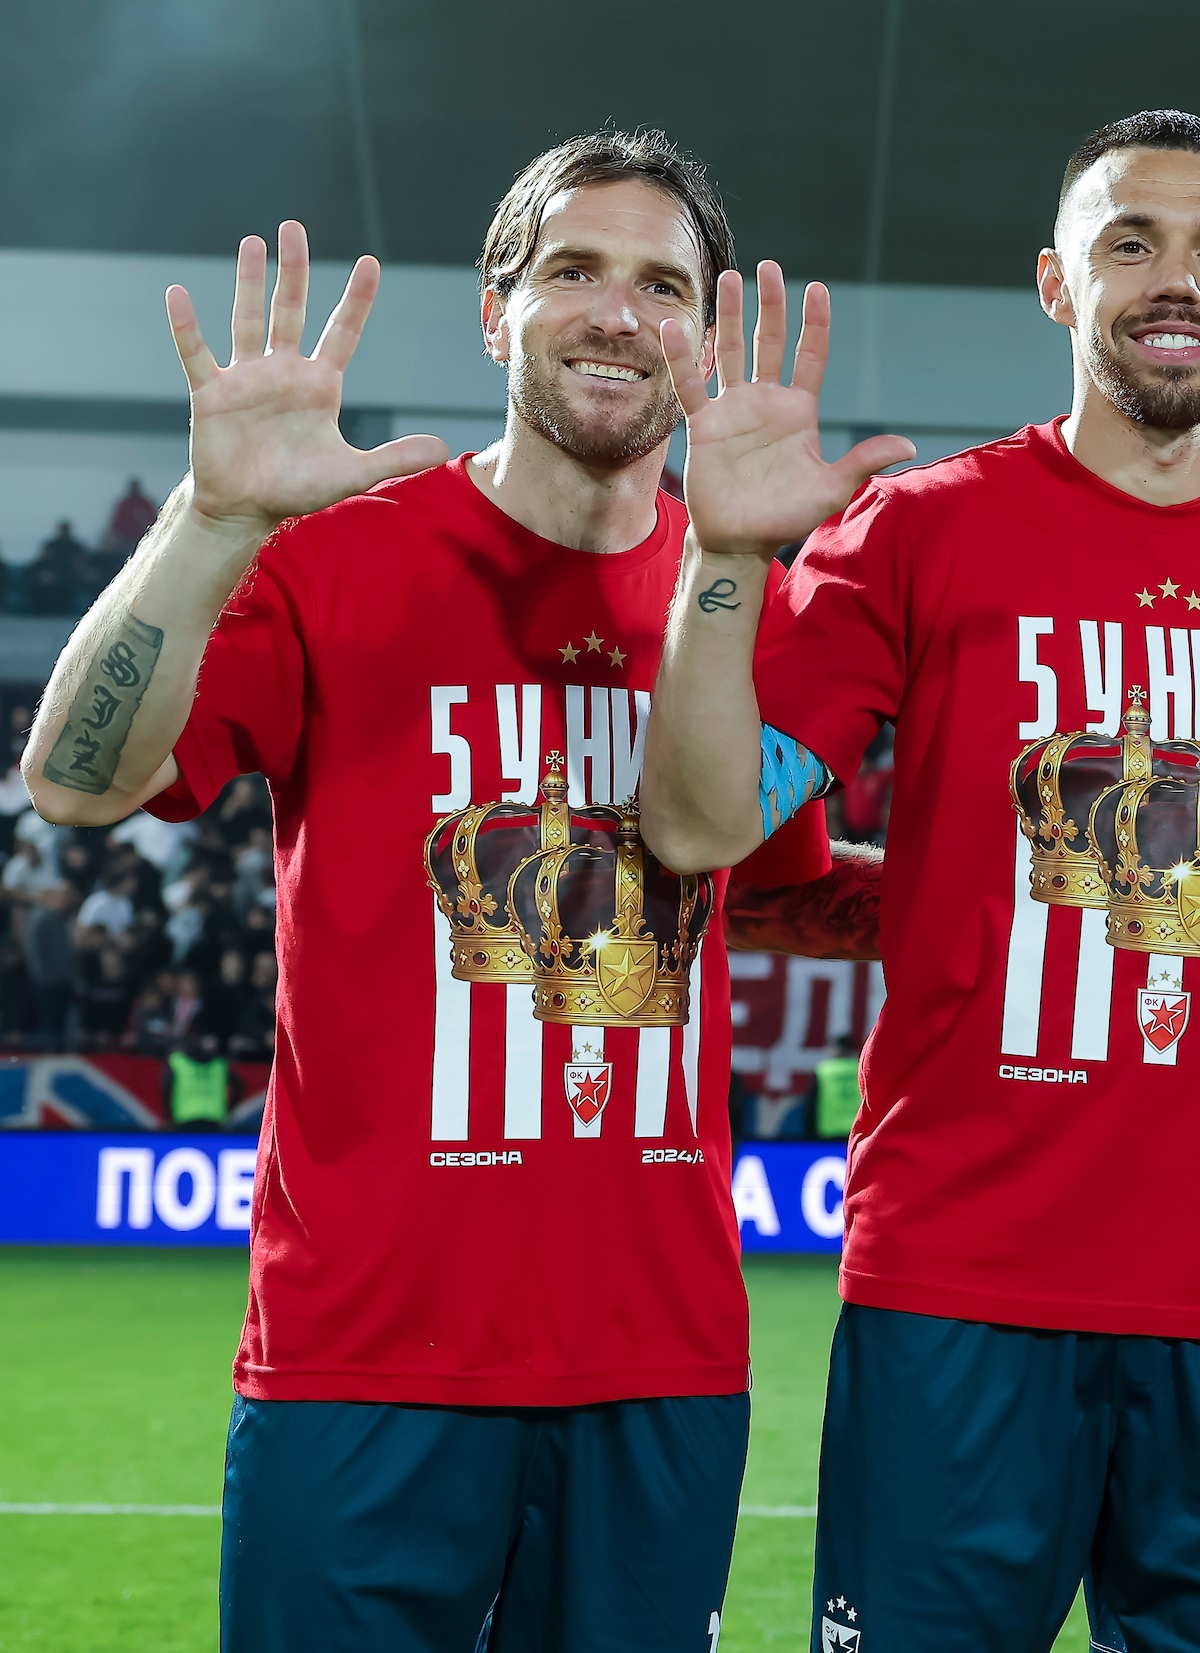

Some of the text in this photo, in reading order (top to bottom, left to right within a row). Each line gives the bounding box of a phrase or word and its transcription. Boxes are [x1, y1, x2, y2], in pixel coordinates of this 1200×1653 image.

[1016, 615, 1058, 741] 5
[1078, 619, 1123, 738] У
[429, 685, 473, 814] 5
[494, 684, 542, 807] У
[1144, 998, 1159, 1007] ФК
[570, 1071, 583, 1080] ФК
[997, 1063, 1089, 1085] СЕЗОНА
[428, 1150, 523, 1168] СЕЗОНА
